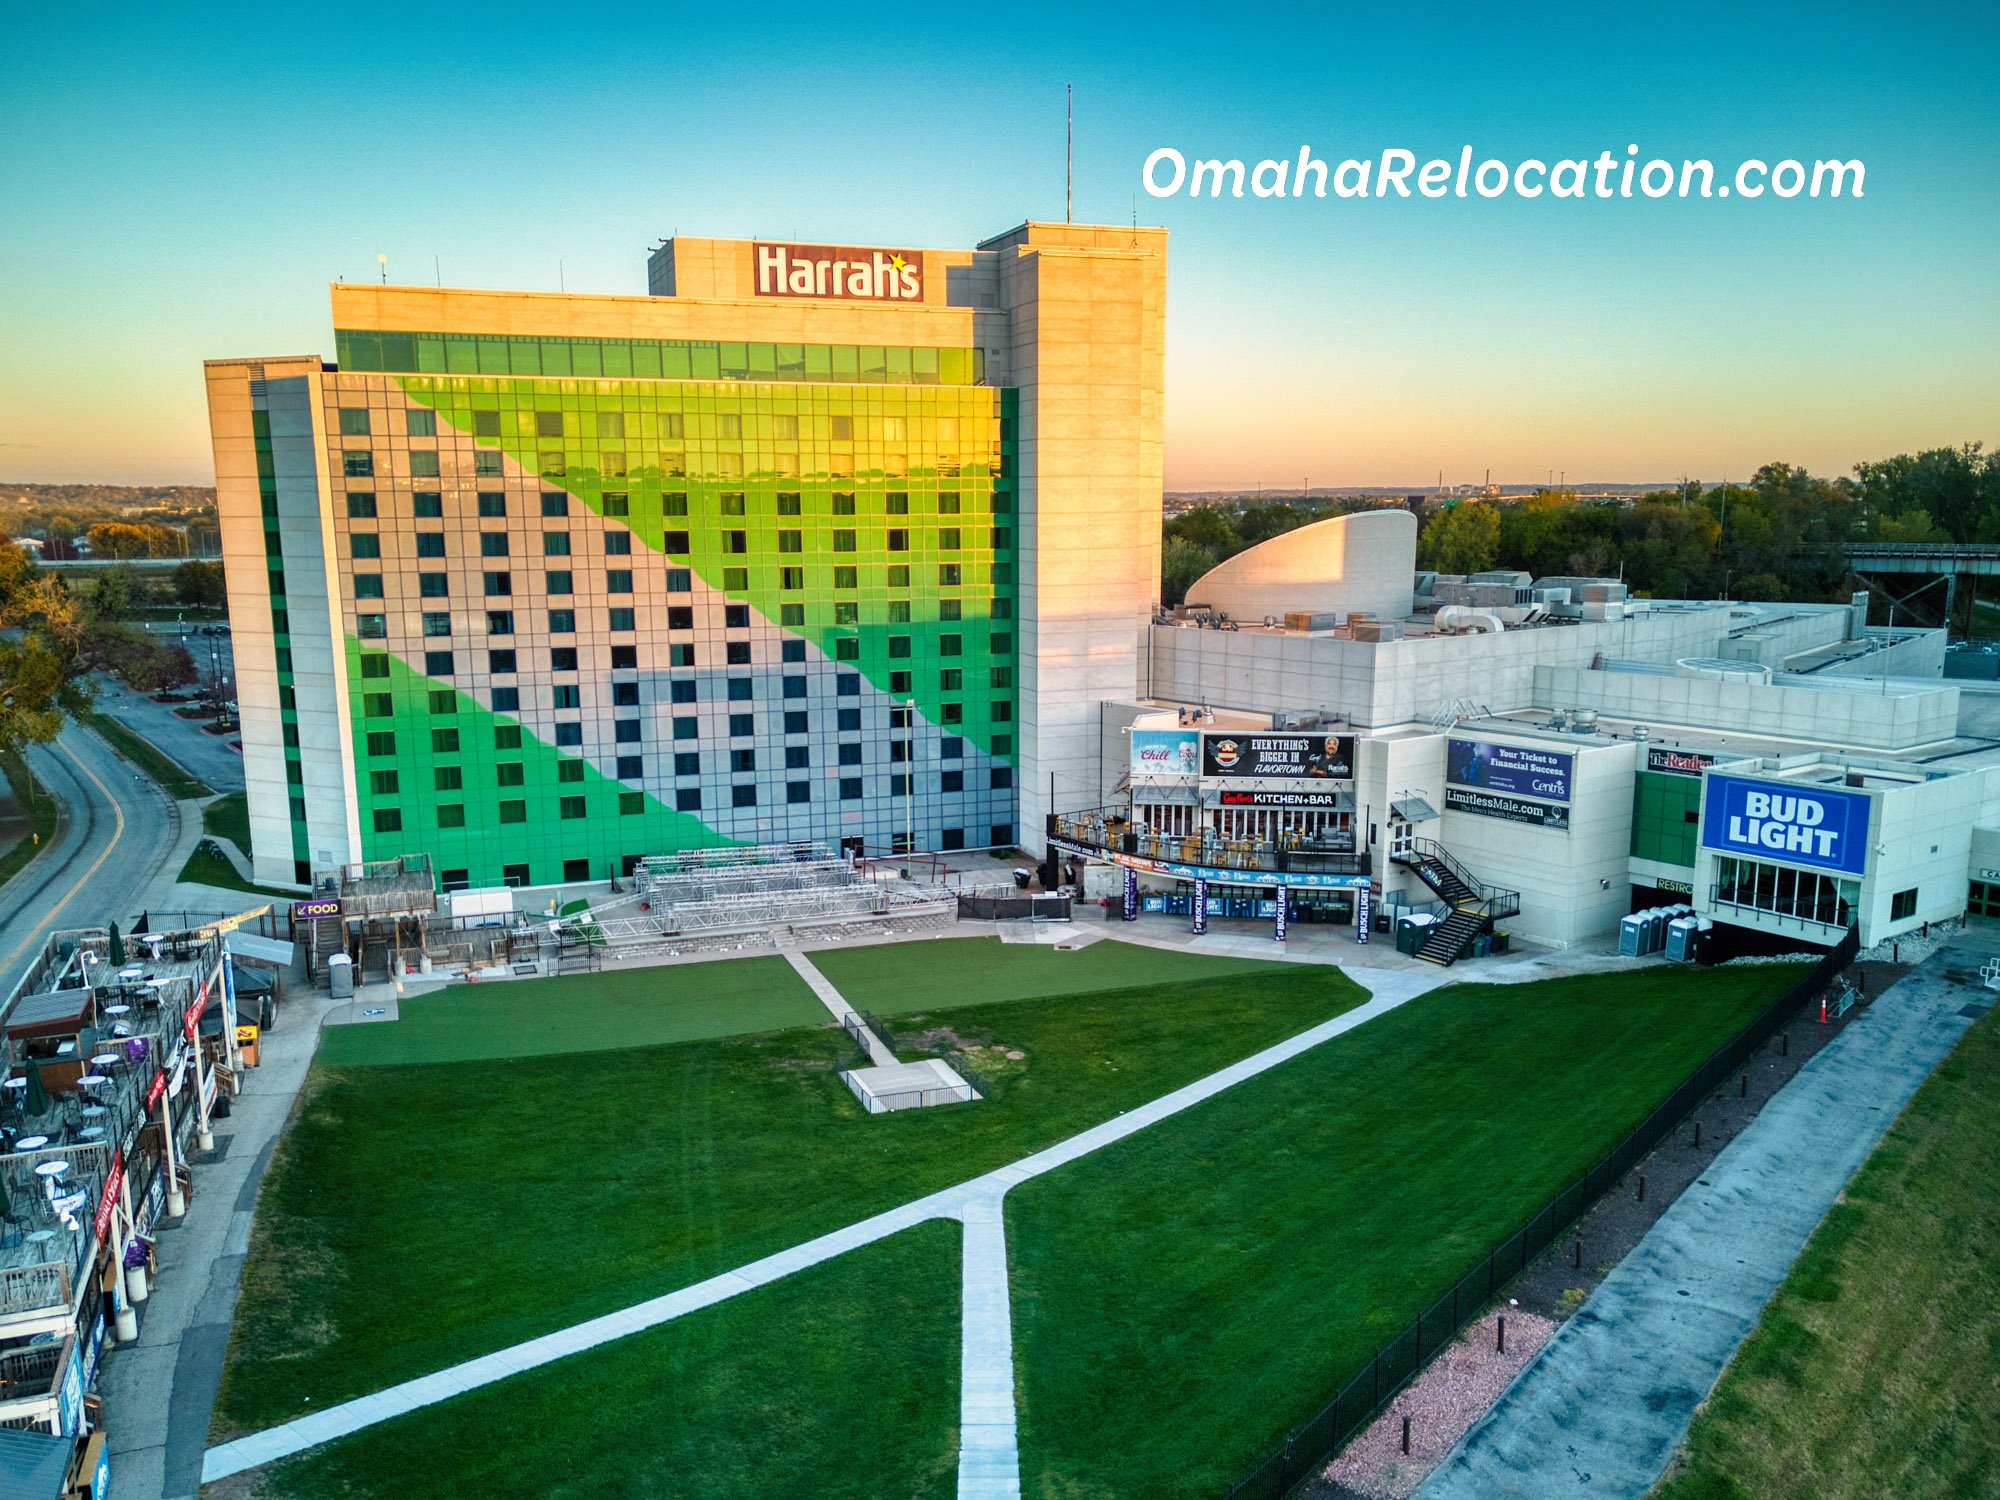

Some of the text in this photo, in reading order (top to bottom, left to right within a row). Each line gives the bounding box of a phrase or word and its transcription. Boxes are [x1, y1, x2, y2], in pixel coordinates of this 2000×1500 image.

[1260, 752, 1300, 763] BIGGER IN
[1490, 758, 1529, 771] Financial
[1499, 749, 1558, 765] Your Ticket to
[1650, 752, 1667, 766] The
[1254, 764, 1306, 774] FLAVORTOWN
[1532, 779, 1565, 795] Centris
[1446, 790, 1544, 817] LimitlessMale.com
[1746, 791, 1824, 826] BUD
[1729, 815, 1838, 857] LIGHT
[307, 903, 338, 914] FOOD
[1195, 900, 1203, 923] BUSCH
[1277, 886, 1286, 930] BUSCH LIGHT
[1360, 889, 1369, 933] BUSCH LIGHT
